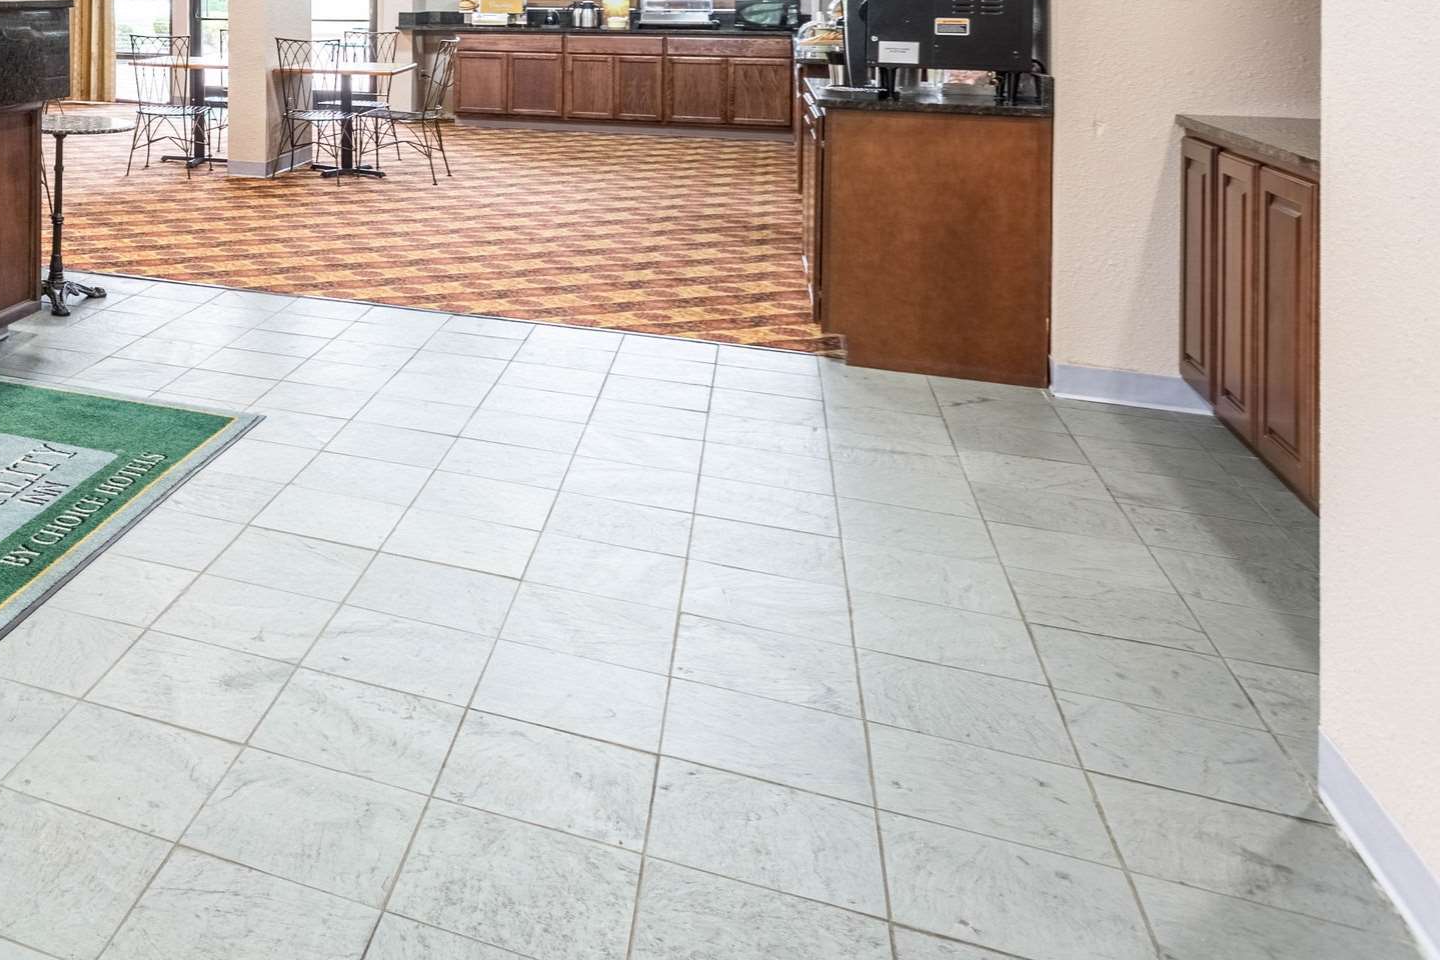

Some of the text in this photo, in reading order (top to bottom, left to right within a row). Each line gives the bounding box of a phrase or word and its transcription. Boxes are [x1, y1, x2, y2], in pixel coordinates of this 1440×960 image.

[0, 450, 168, 568] BY CHOICE HOTELS
[18, 479, 71, 507] INN
